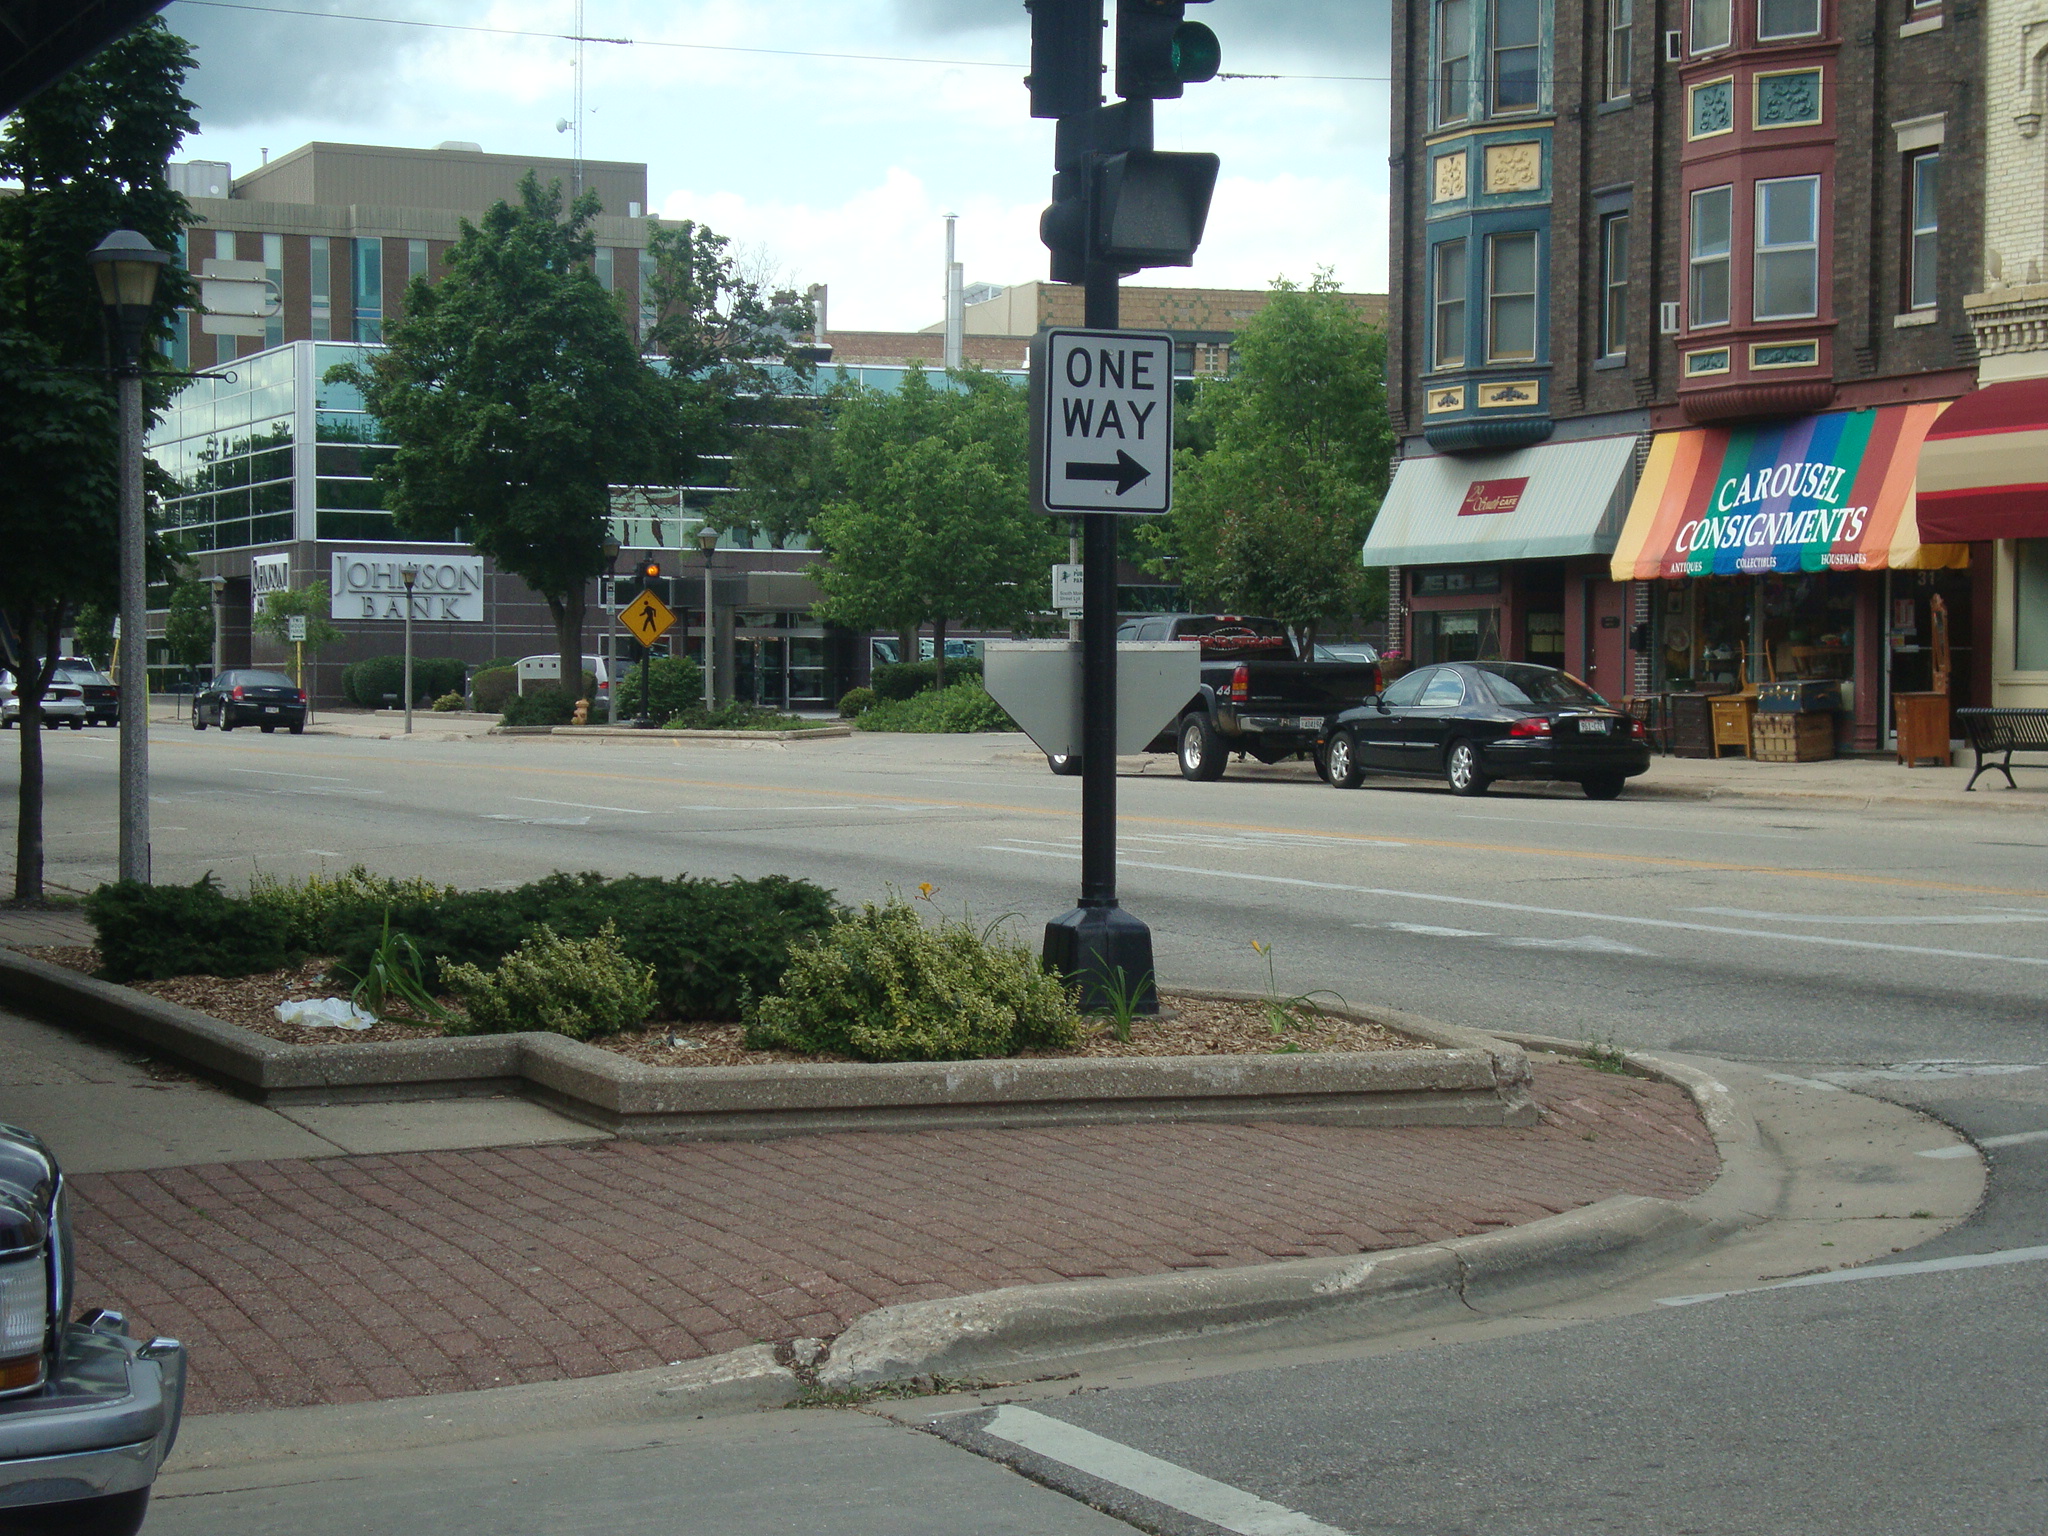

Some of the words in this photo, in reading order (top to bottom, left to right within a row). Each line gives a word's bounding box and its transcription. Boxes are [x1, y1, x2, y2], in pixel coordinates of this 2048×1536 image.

[1066, 347, 1155, 390] ONE
[1062, 397, 1157, 440] WAY
[1717, 462, 1847, 512] CAROUSEL
[1675, 506, 1868, 553] CONSIGNMENTS
[334, 556, 483, 596] JOHNSON
[1670, 561, 1703, 574] ANTIQUES
[1735, 556, 1777, 569] COLLECTIBLES
[1821, 553, 1867, 566] HOUSEWARES
[361, 596, 461, 619] BANK
